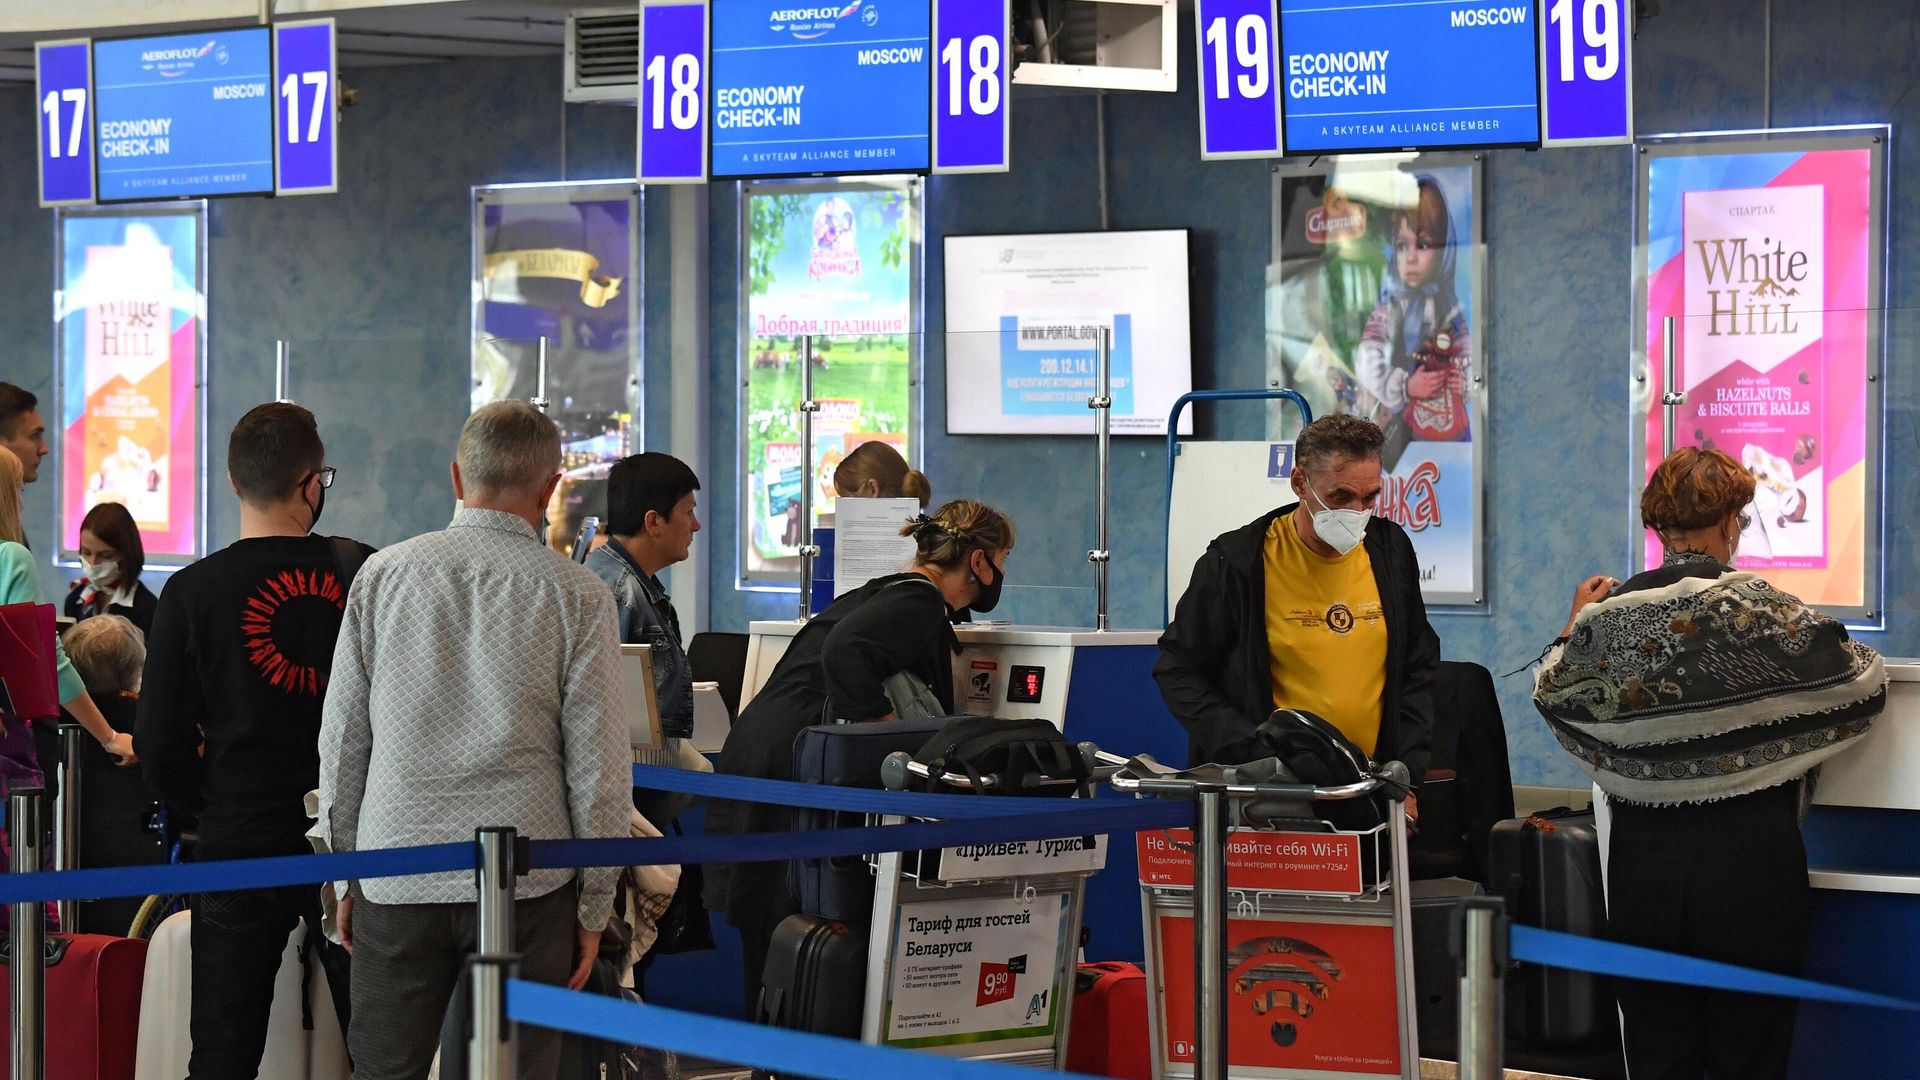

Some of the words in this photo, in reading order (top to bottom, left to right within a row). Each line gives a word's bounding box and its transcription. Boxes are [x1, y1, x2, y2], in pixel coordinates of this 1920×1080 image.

[769, 7, 841, 22] AEROFLOT
[1450, 7, 1526, 28] MOSCOW
[790, 23, 812, 31] Russian
[813, 22, 836, 30] Airlines
[1551, 0, 1620, 82] 19
[142, 48, 199, 61] AEROFLOT
[858, 48, 923, 65] MOSCOW
[1206, 13, 1269, 100] 19
[1289, 50, 1389, 75] ECONOMY
[942, 35, 1000, 117] 18
[1290, 73, 1386, 98] CHECK-IN
[213, 83, 266, 100] MOSCOW
[647, 53, 700, 130] 18
[717, 86, 804, 108] ECONOMY
[282, 70, 328, 144] 17
[43, 88, 86, 158] 17
[717, 107, 801, 129] CHECK-IN
[1321, 127, 1327, 136] A
[1333, 124, 1384, 136] SKYTEAM
[1390, 122, 1445, 133] ALLIANCE
[1451, 120, 1500, 131] MEMBER
[101, 118, 172, 139] ECONOMY
[102, 138, 169, 158] CHECK-IN
[743, 154, 749, 162] A
[753, 152, 797, 162] SKYTEAM
[802, 150, 849, 161] ALLIANCE
[854, 148, 896, 158] MEMBER
[132, 178, 168, 187] SKYTEAM
[171, 176, 209, 186] ALLIANCE
[213, 174, 247, 184] MEMBER
[1729, 205, 1776, 217] СПАРТАК
[1693, 237, 1808, 285] White
[755, 314, 818, 339] Добрая
[824, 314, 908, 338] традиция!
[1737, 377, 1755, 385] white
[1756, 377, 1770, 385] with
[1716, 387, 1791, 401] HAZELNUTS
[1697, 404, 1706, 416] &
[1710, 402, 1767, 416] BISCUITE
[1770, 401, 1810, 415] BALLS
[1036, 836, 1086, 857] Турис
[1146, 837, 1164, 850] Не
[1276, 842, 1307, 856] себя
[1312, 843, 1348, 857] Wi-Fi
[1148, 856, 1192, 865] Подключите
[1244, 861, 1277, 869] интернет
[1285, 863, 1320, 871] роуминге
[908, 915, 952, 934] Тариф
[956, 916, 981, 931] для
[985, 909, 1031, 927] гостей
[906, 941, 973, 958] Беларуси
[984, 973, 996, 996] 9
[996, 972, 1008, 984] 90
[995, 987, 1008, 996] руб.
[1026, 989, 1048, 1020] A1
[1314, 1054, 1332, 1063] Услуга
